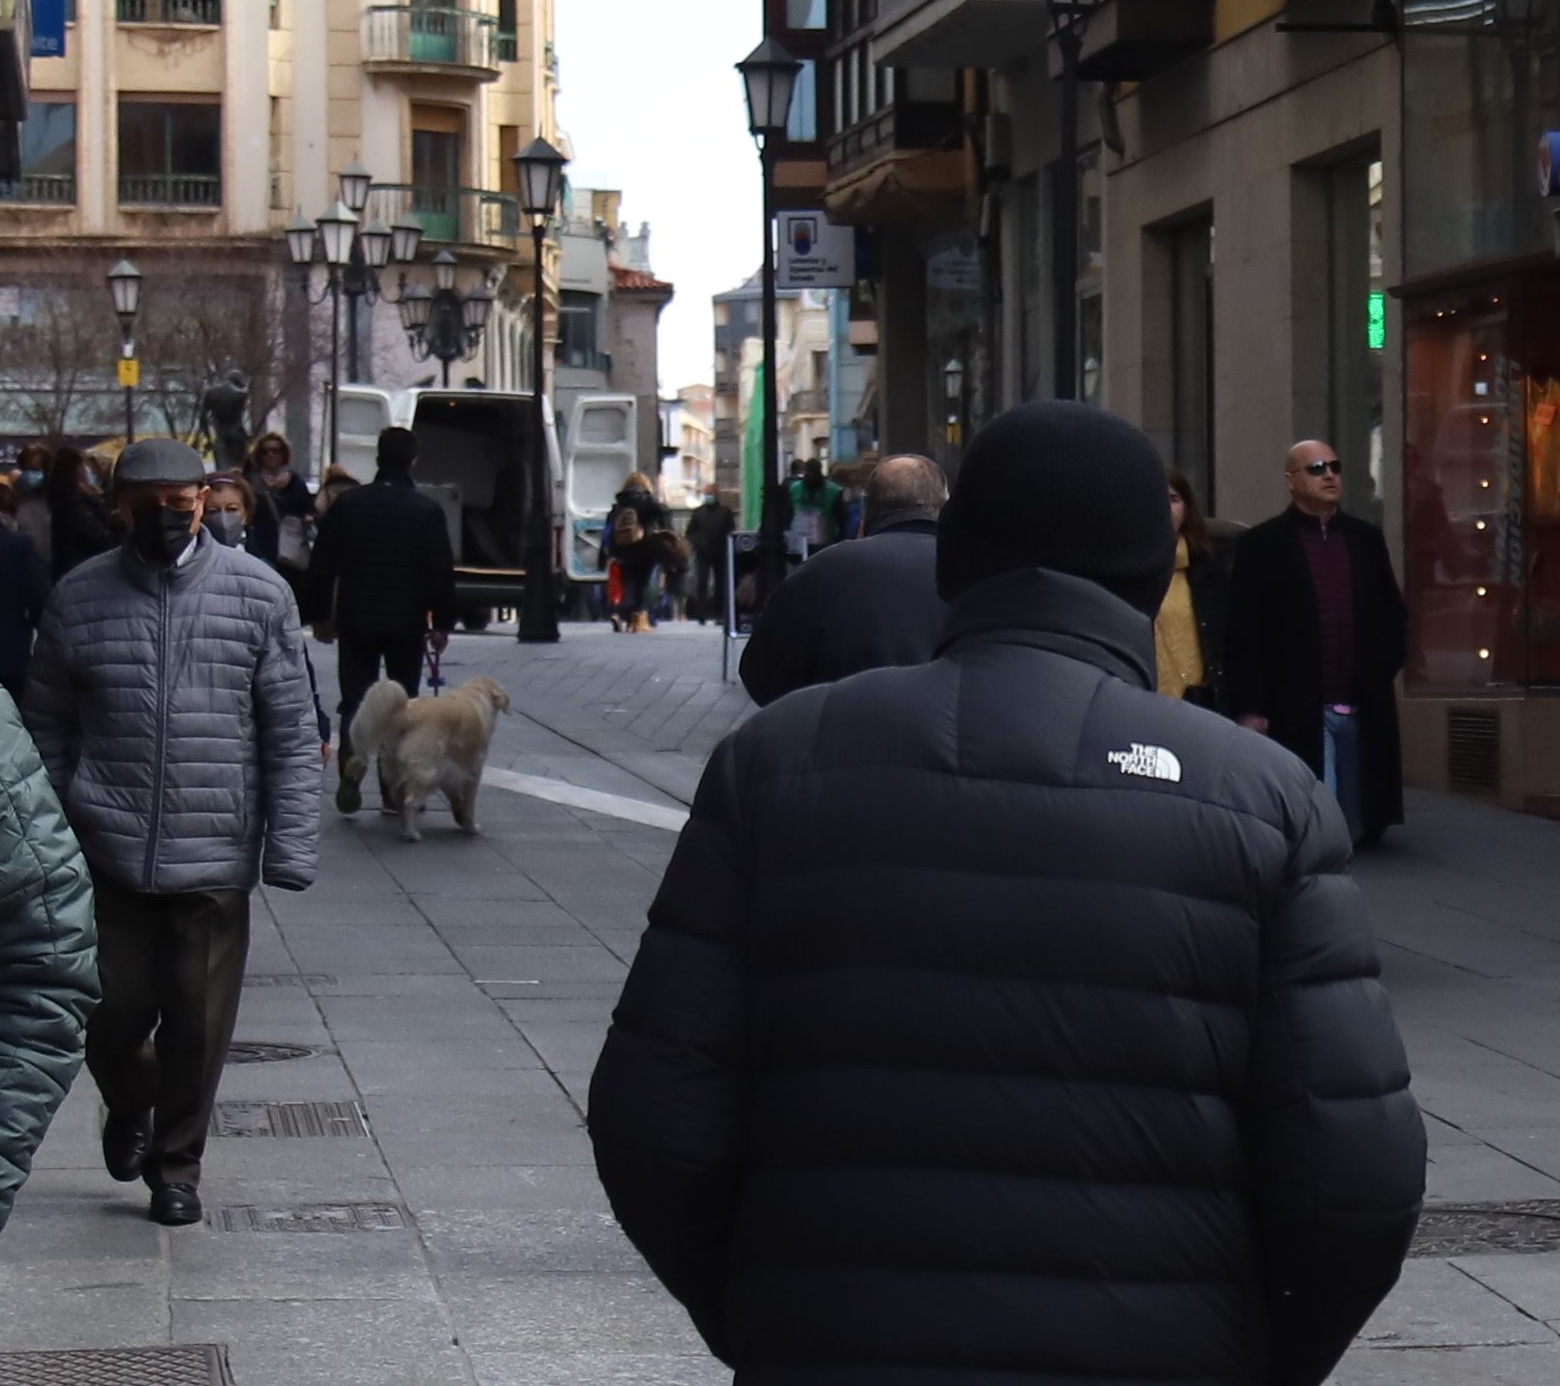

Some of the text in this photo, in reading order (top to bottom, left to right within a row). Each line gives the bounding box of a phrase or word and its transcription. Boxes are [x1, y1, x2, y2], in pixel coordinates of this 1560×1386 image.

[1130, 742, 1157, 757] THE
[1107, 750, 1157, 768] NORTH
[1120, 762, 1155, 777] FACE
